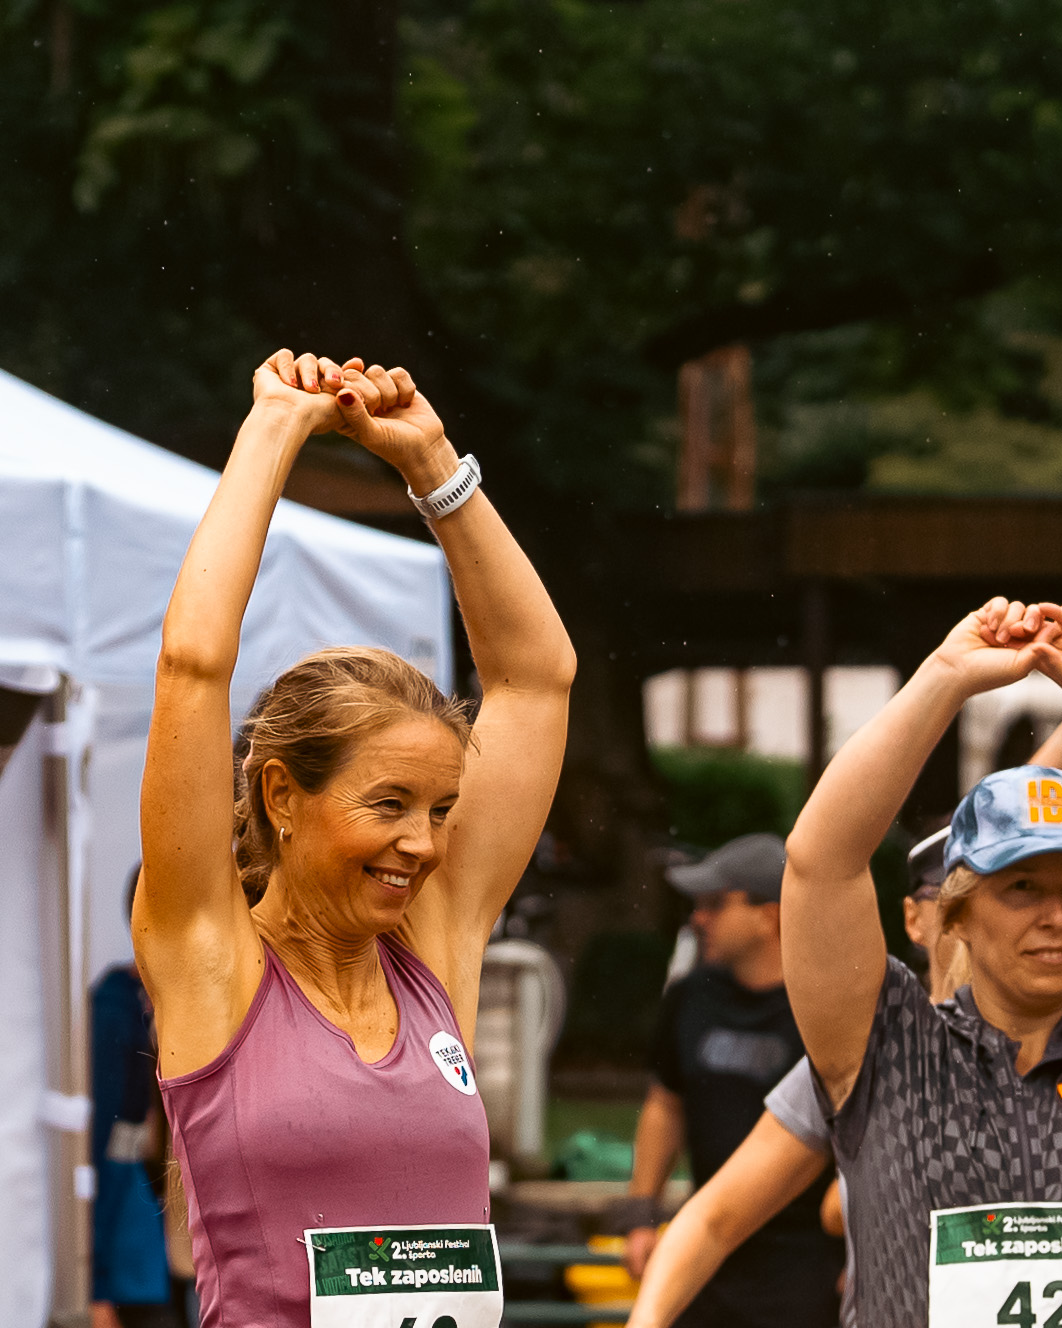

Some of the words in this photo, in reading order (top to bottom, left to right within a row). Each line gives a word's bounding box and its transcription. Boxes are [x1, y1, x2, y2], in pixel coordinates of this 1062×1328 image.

[1002, 1216, 1019, 1233] 2.
[391, 1241, 408, 1260] 2.
[961, 1239, 998, 1257] Tek
[345, 1267, 387, 1287] Tek
[390, 1264, 483, 1288] zaposlenih
